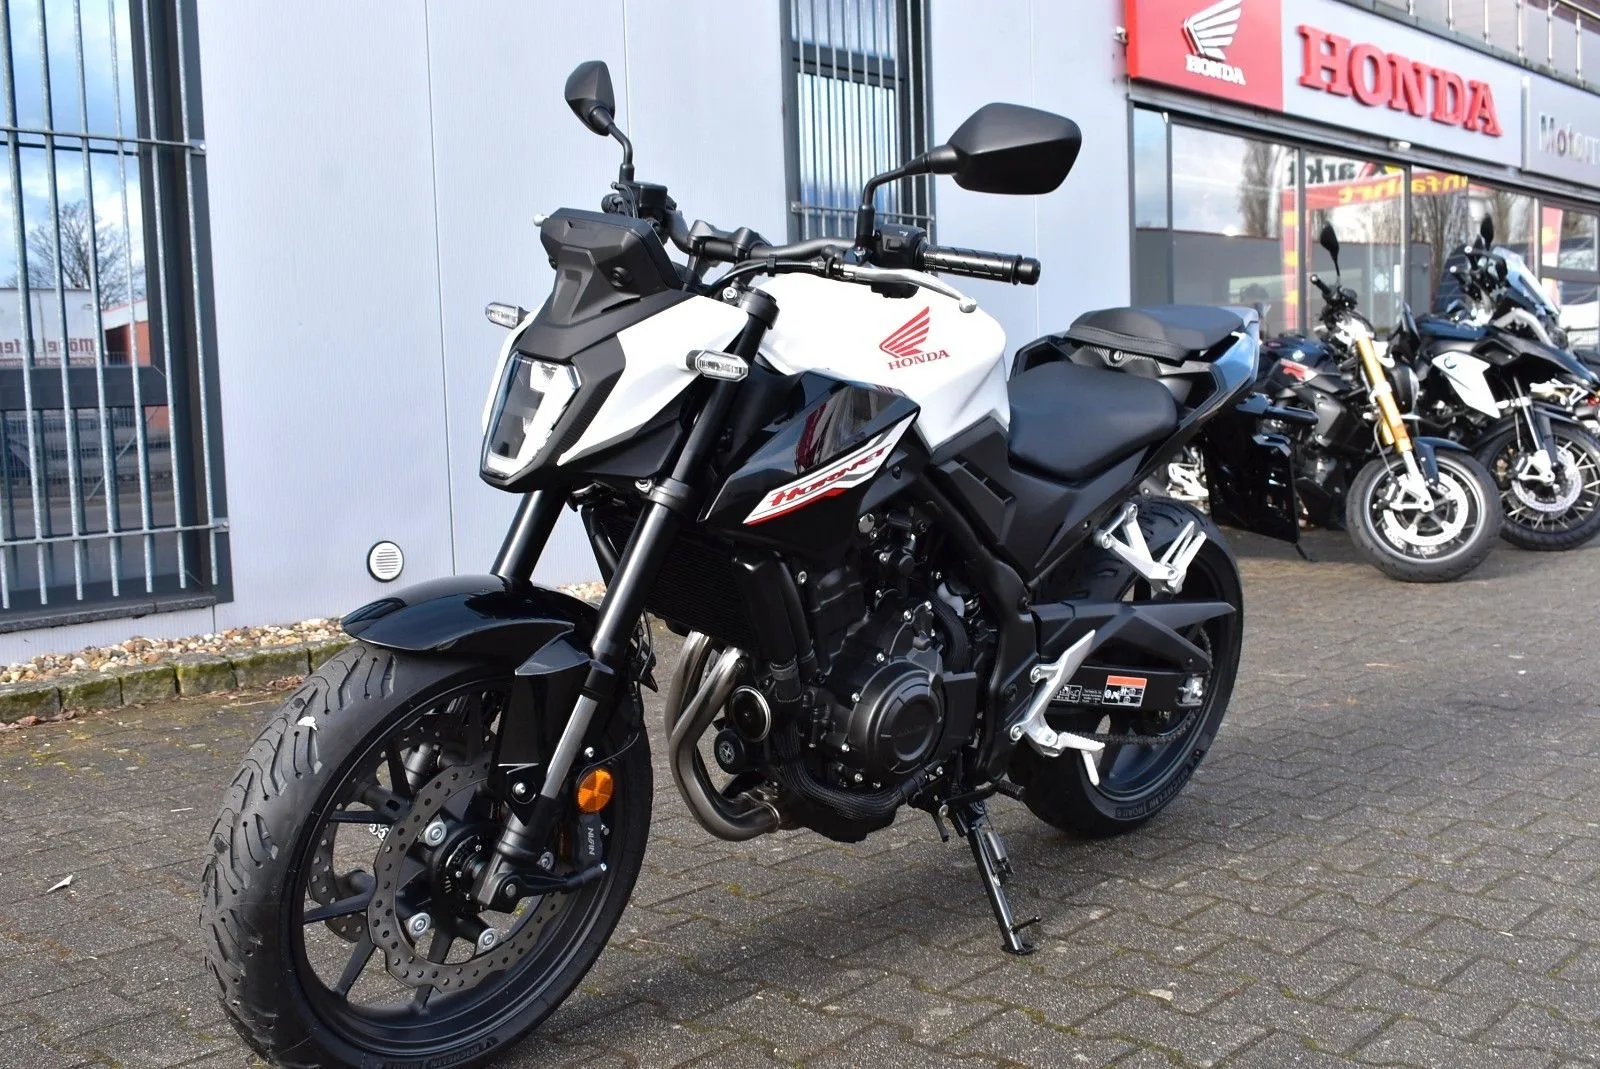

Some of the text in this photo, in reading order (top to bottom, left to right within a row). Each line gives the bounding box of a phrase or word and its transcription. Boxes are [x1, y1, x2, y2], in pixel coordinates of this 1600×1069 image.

[1185, 53, 1247, 86] HONDA
[1296, 24, 1503, 137] HONDA
[888, 349, 951, 370] HONDA
